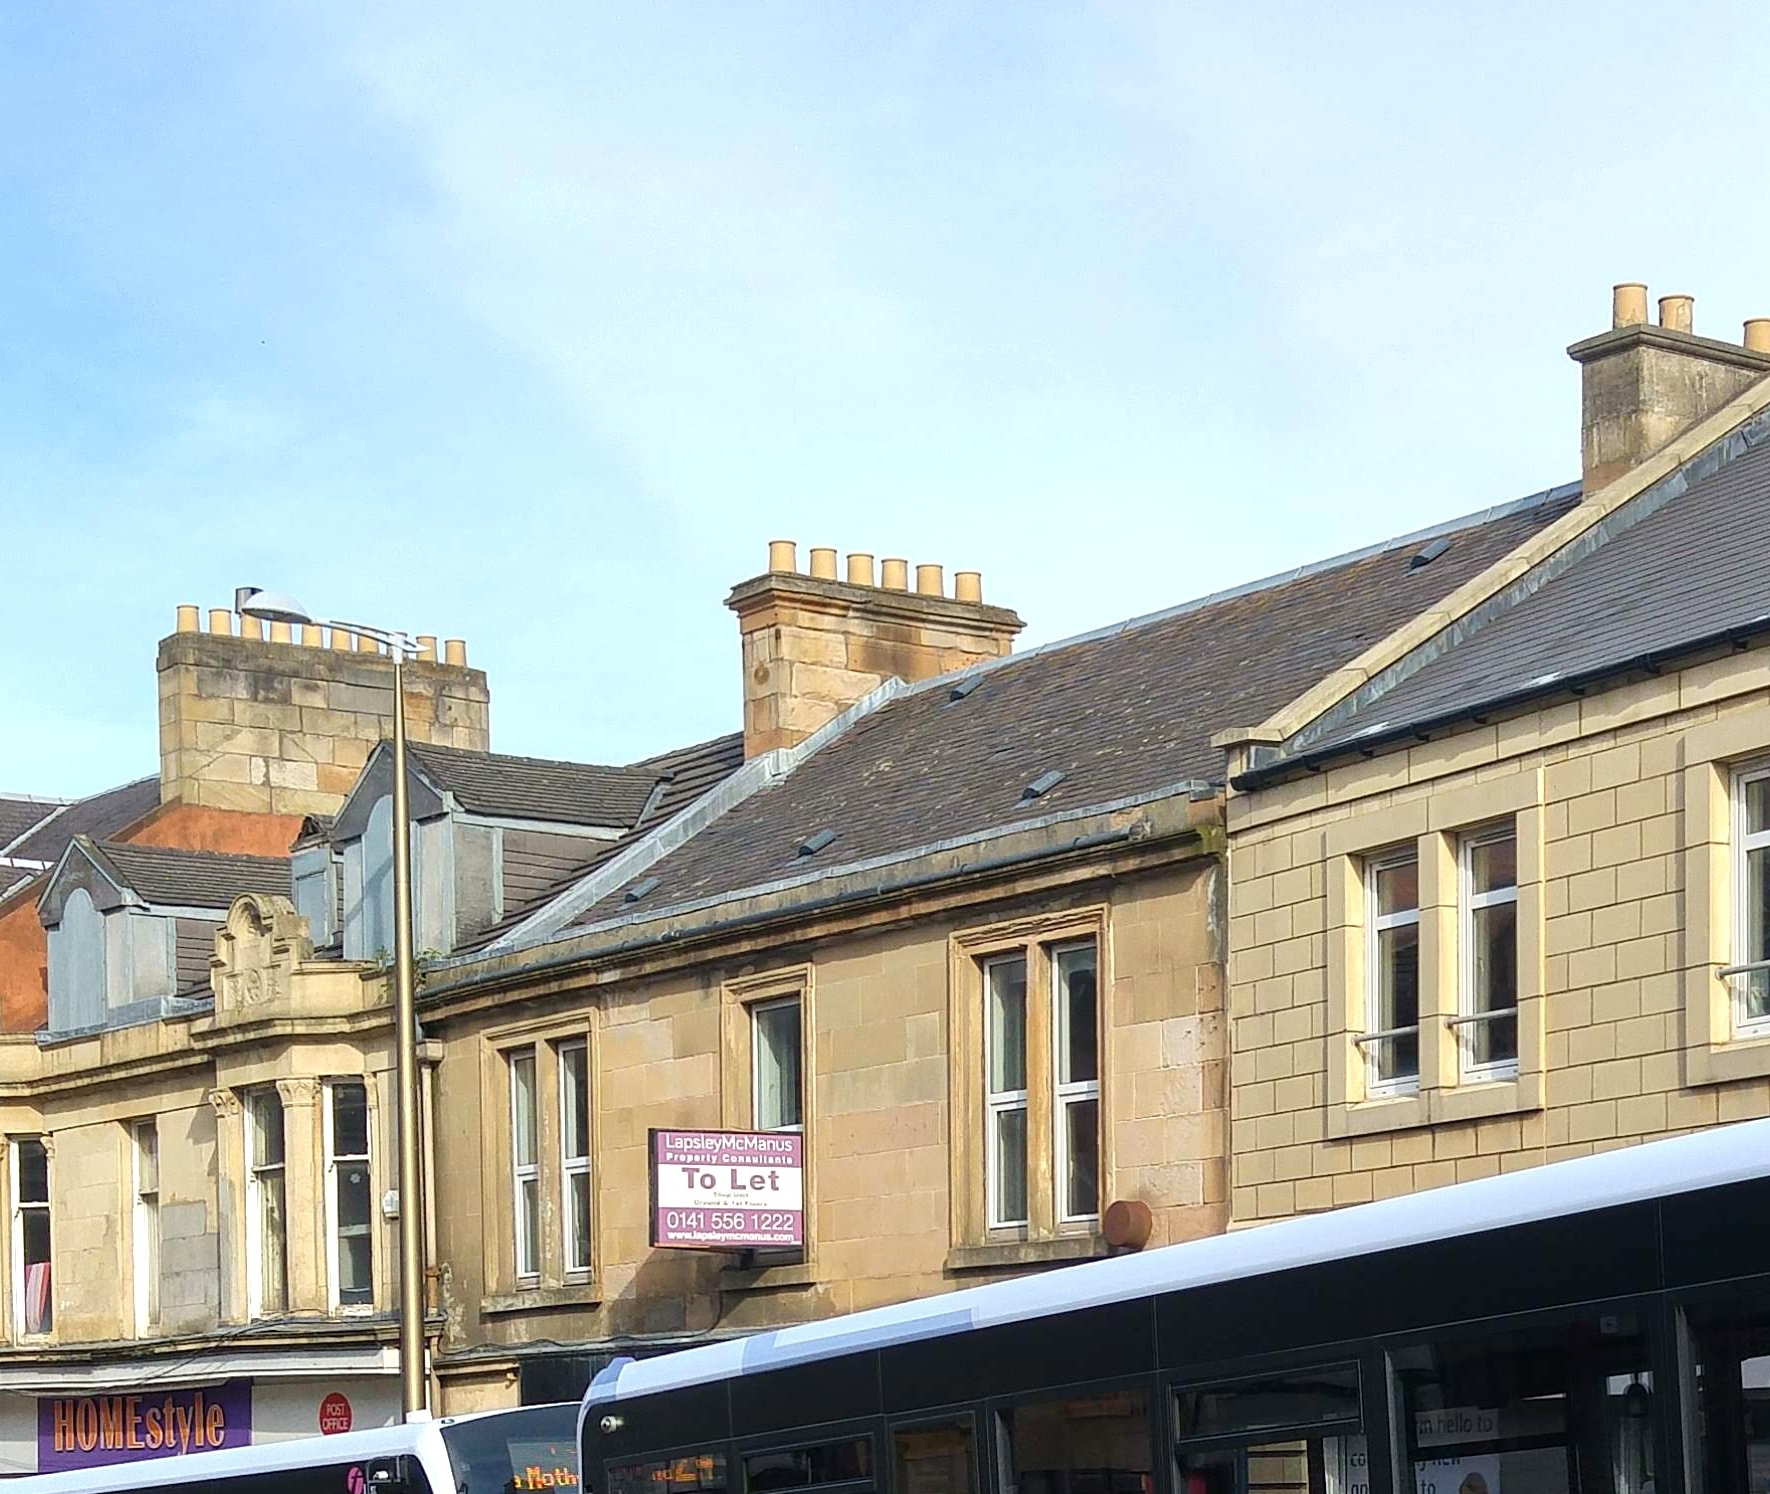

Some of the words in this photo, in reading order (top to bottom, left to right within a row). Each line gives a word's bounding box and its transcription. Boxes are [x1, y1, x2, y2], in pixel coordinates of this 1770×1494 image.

[666, 1133, 793, 1152] LapsleyMcManus
[666, 1152, 717, 1163] Property
[722, 1154, 793, 1164] Consultants
[682, 1167, 716, 1189] To
[730, 1168, 780, 1191] Let
[667, 1211, 706, 1229] 0141
[711, 1212, 745, 1230] 556
[751, 1213, 794, 1231] 1222
[667, 1231, 795, 1241] www.lapsleymcmanus.com
[326, 1403, 345, 1416] POST
[54, 1391, 225, 1456] HOMEstyle
[322, 1417, 349, 1430] OFFICE
[1437, 1413, 1472, 1434] hello
[1478, 1415, 1493, 1432] to
